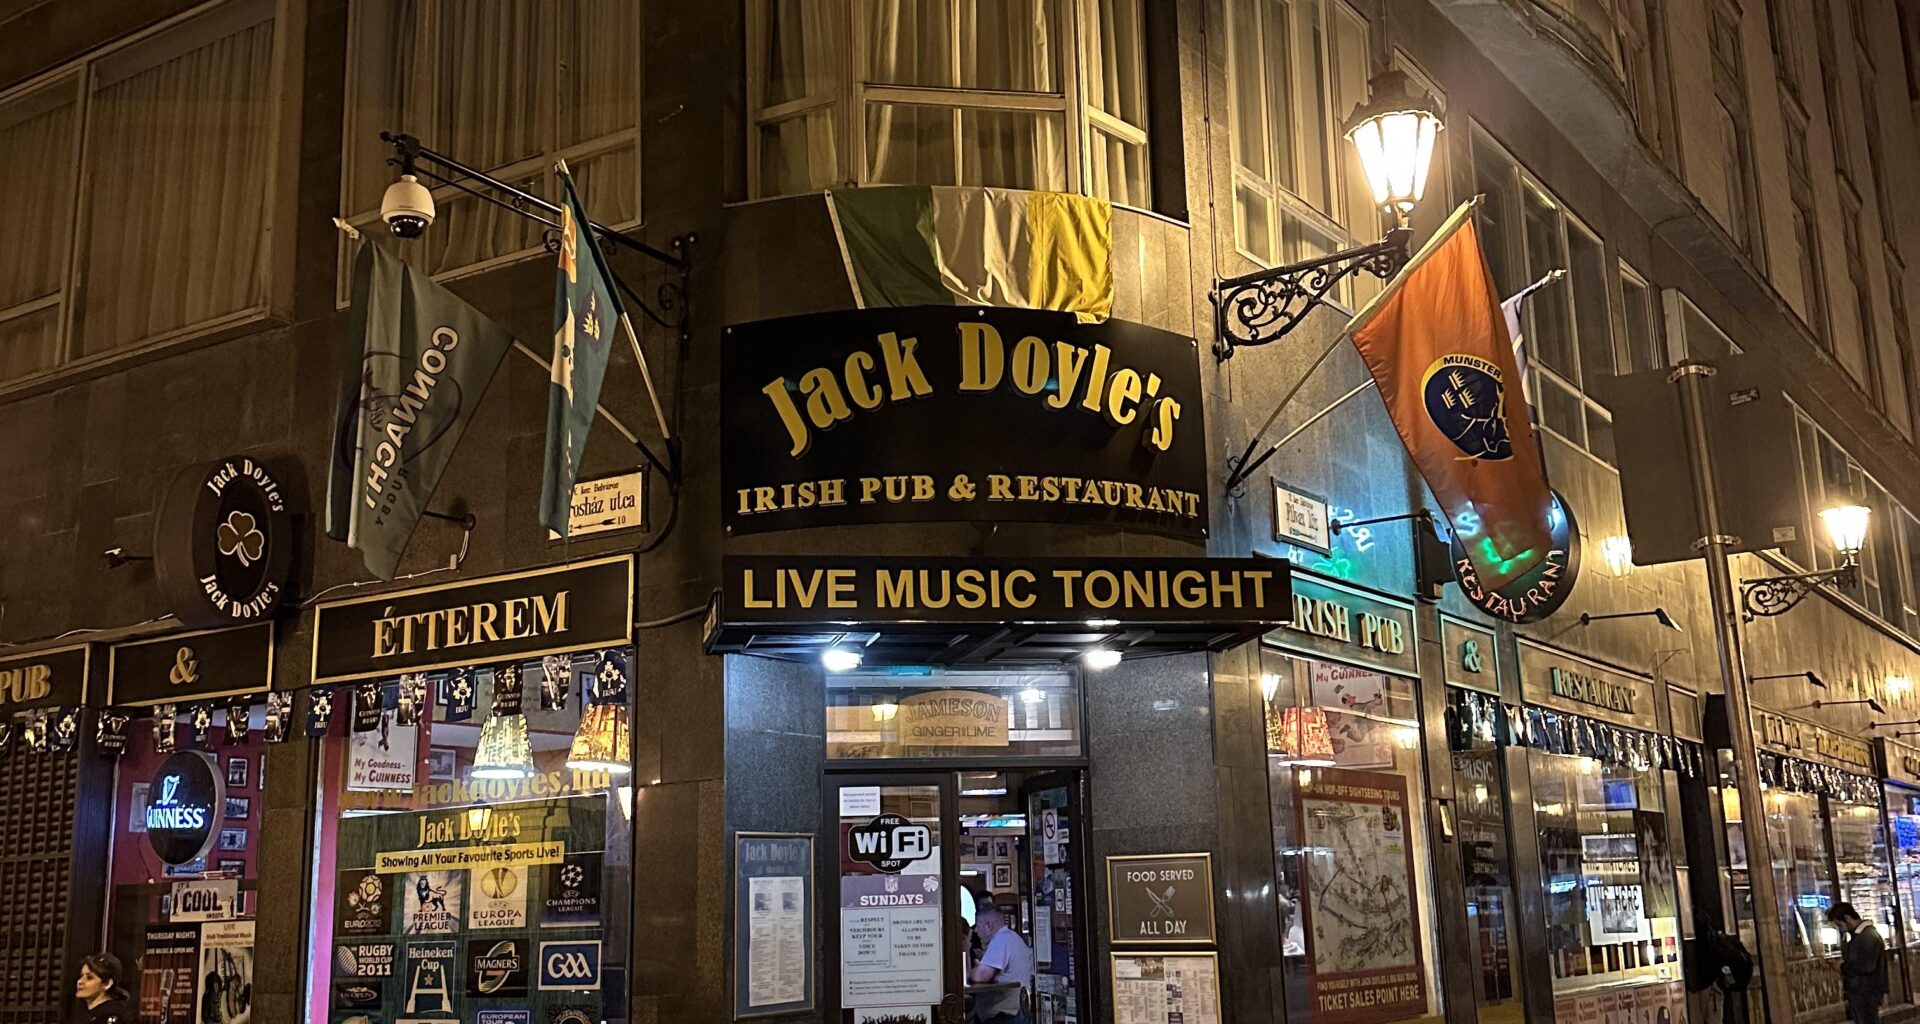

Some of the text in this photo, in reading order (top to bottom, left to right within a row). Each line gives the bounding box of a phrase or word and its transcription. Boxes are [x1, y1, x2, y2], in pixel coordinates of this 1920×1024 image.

[1443, 355, 1501, 379] MUNSTER
[763, 322, 1181, 458] Jack Doyle's
[207, 459, 284, 512] Jack Doyle's
[738, 474, 1199, 518] IRISH PUB & RESTAURANT
[610, 490, 635, 511] utca
[200, 574, 280, 618] Jack Doyle's
[744, 567, 1272, 610] LIVE MUSIC TONIGHT
[371, 590, 570, 658] ÉTTEREM
[1292, 592, 1404, 655] RISH PUB
[169, 647, 199, 685] &
[1465, 640, 1484, 673] &
[0, 664, 51, 704] PUB
[1316, 672, 1329, 683] My
[1552, 667, 1636, 714] RESTAURANT
[906, 697, 1002, 724] JAMESON
[912, 726, 961, 737] GINGER
[966, 726, 997, 737] LIME
[354, 758, 366, 769] My
[354, 770, 412, 784] My GUINNESS
[1349, 786, 1383, 799] SIGHTSEEING
[147, 805, 204, 829] GUINNESS
[417, 810, 521, 848] Jack Dyle's
[381, 846, 560, 868] Showing All Your Favourite Sports Live!
[1127, 869, 1194, 882] FOOD SERVED
[182, 889, 223, 912] COOL
[546, 898, 597, 907] CHAMPIONS
[860, 894, 924, 906] SUNDAYS
[413, 912, 452, 922] PREMIER
[473, 910, 522, 919] EUROPA
[478, 919, 516, 927] LEAGUE
[414, 921, 449, 931] LEAGUE
[1140, 920, 1187, 935] ALL DAY
[358, 945, 393, 956] RUGBY
[409, 947, 454, 958] Heineken
[357, 964, 391, 976] 2011
[421, 959, 439, 972] Cup
[476, 958, 518, 969] MAGNERS
[547, 953, 592, 979] GAA
[1318, 984, 1420, 1012] TICKET SALES POINT HERE
